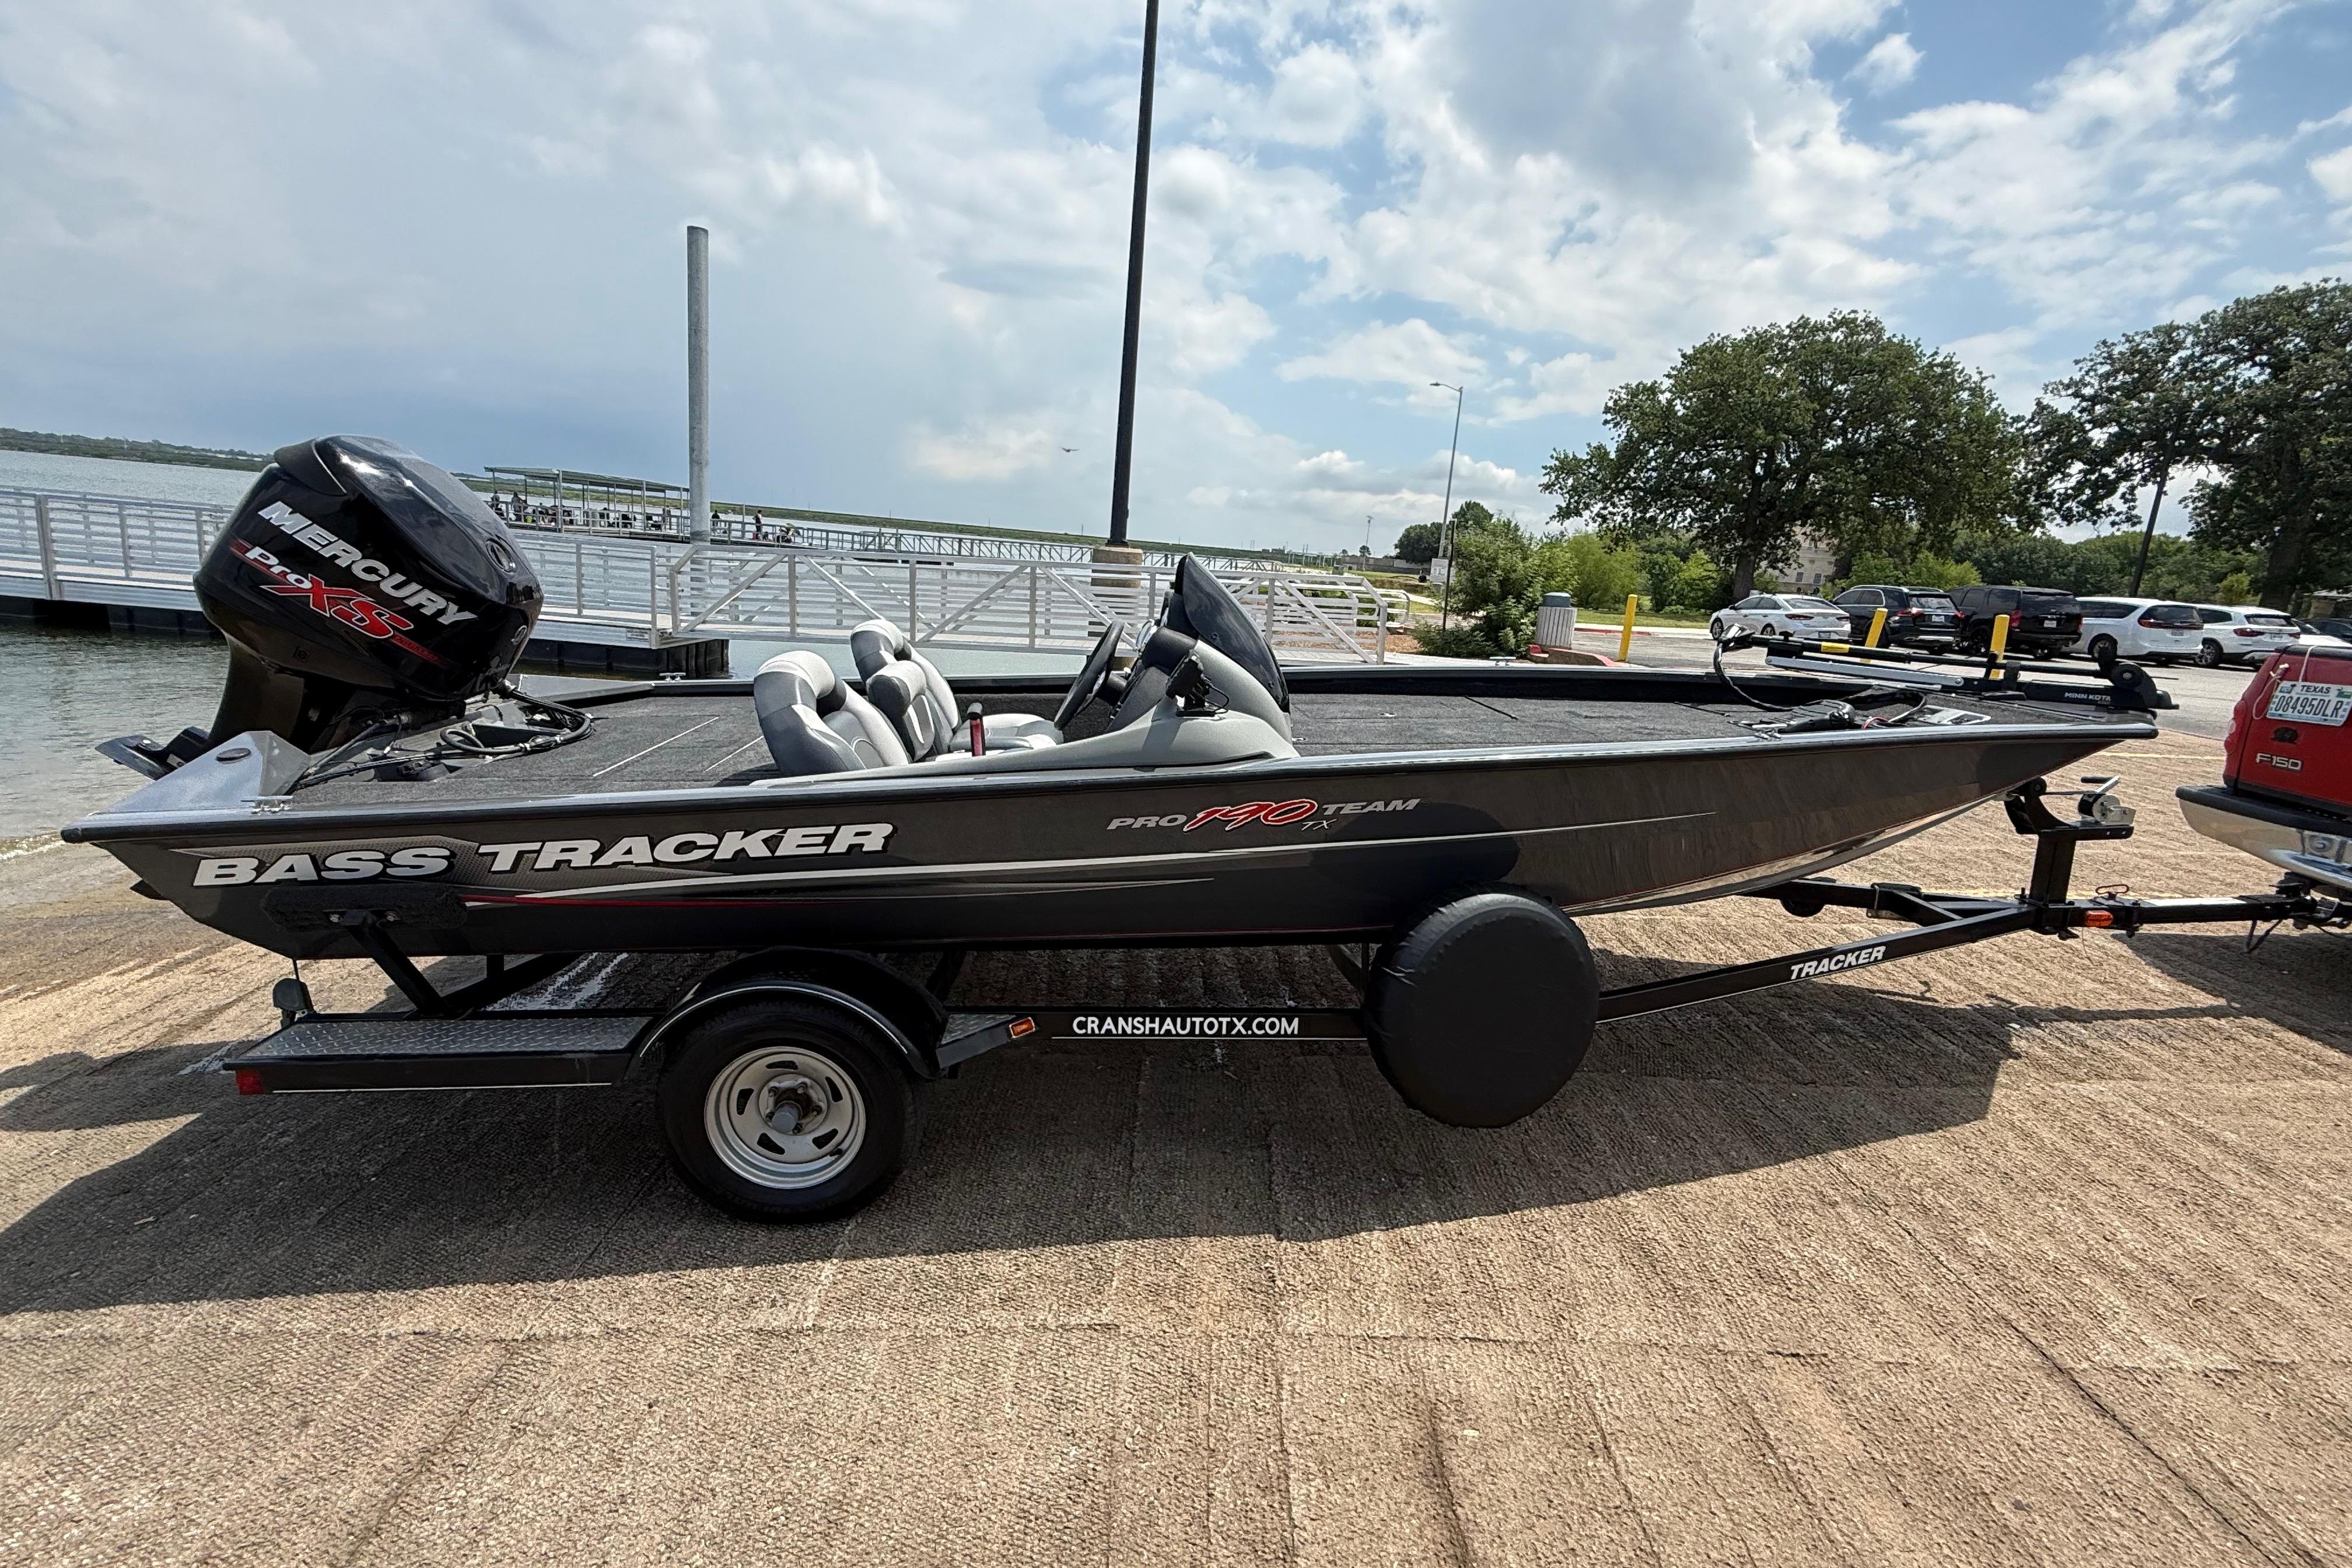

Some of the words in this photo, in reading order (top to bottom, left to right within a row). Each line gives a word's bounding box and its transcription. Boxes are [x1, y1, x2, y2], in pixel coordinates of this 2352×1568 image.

[258, 501, 478, 625] MERCURY
[2300, 684, 2331, 694] TEXAS
[1106, 814, 1188, 831] PRO
[1182, 799, 1319, 833] 190
[1321, 798, 1421, 816] TEAM
[1301, 819, 1338, 832] TX
[193, 847, 451, 887] BASS
[478, 823, 893, 873] TRACKER
[1790, 946, 1886, 980] TRACKER
[1072, 1016, 1299, 1036] CRANSHAUTOTX.COM
